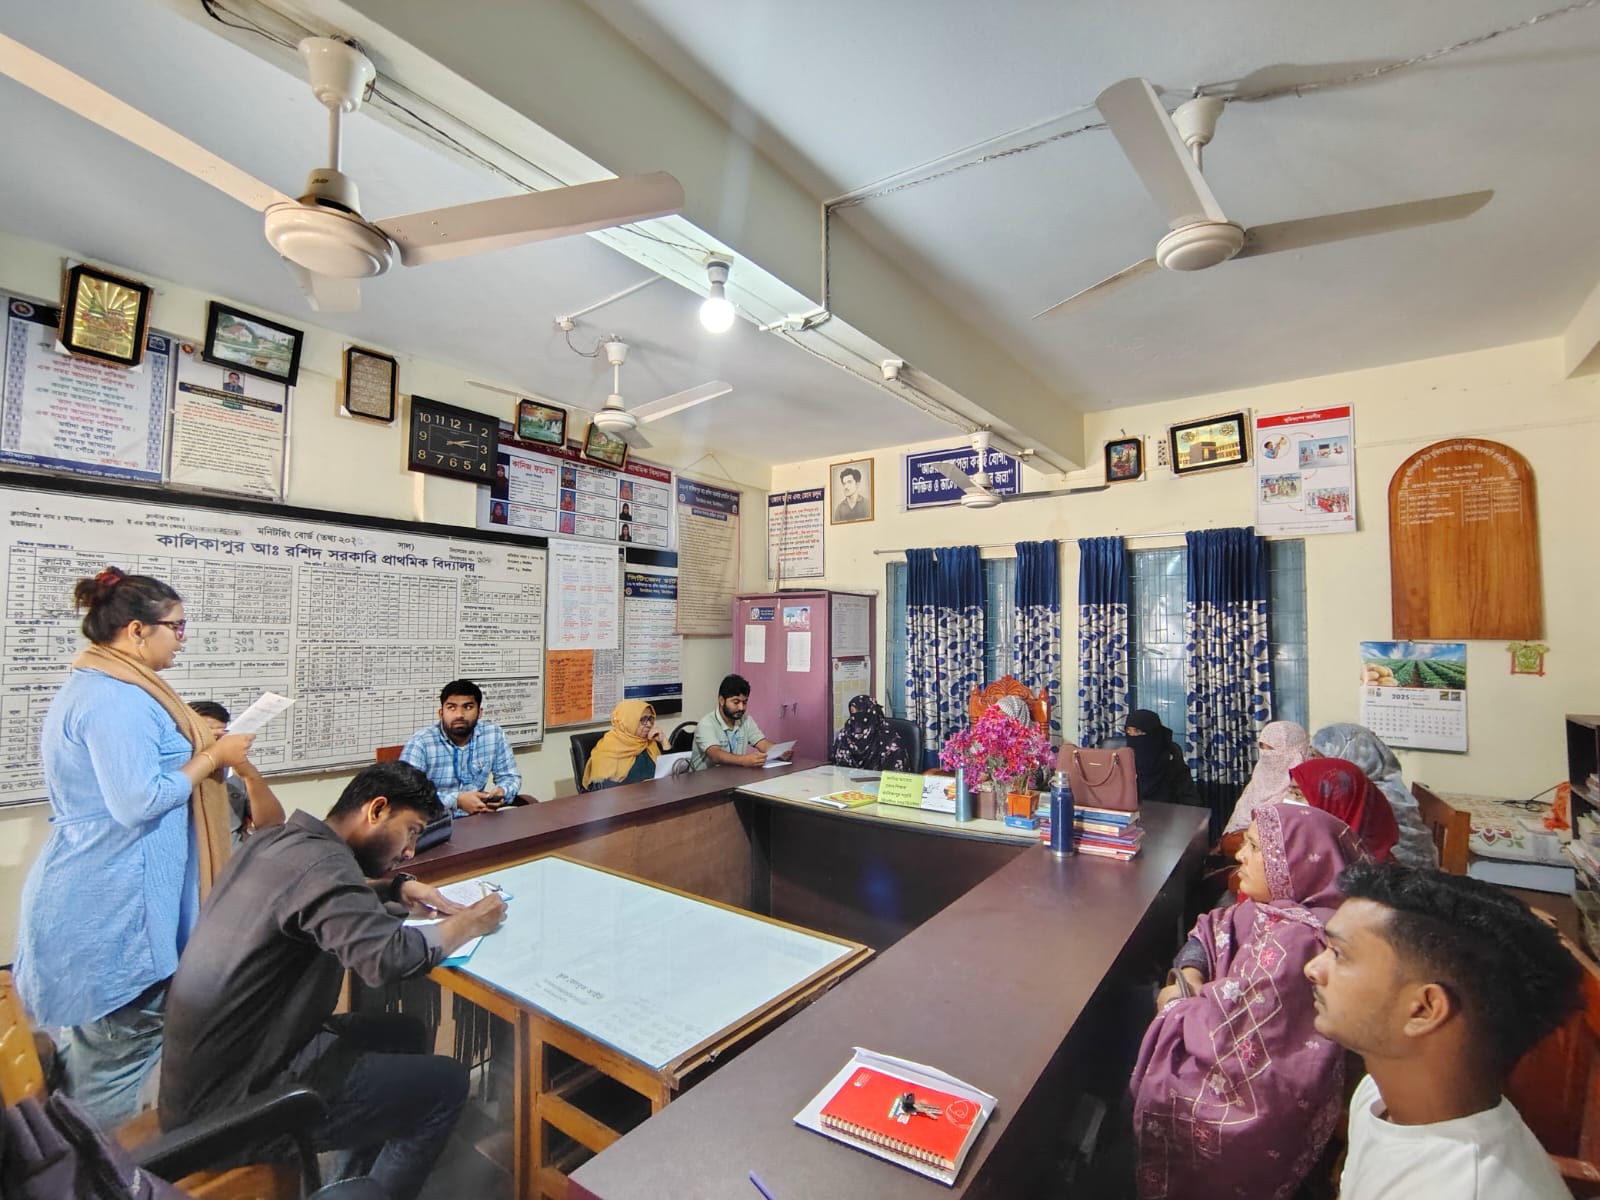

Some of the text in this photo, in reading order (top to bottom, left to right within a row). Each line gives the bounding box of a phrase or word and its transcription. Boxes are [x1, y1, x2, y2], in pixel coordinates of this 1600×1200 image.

[419, 412, 431, 423] 10
[435, 415, 445, 425] 11
[450, 418, 461, 429] 12
[468, 423, 472, 432] 1
[419, 431, 427, 441] 9
[481, 428, 488, 438] 2
[418, 450, 426, 459] 8
[480, 445, 488, 455] 3
[436, 455, 444, 464] 7
[450, 458, 457, 467] 6
[464, 461, 472, 470] 5
[480, 463, 487, 472] 4
[512, 460, 532, 470] কানিজ
[912, 476, 933, 494] শিক্ষিত
[934, 480, 939, 492] ও
[257, 526, 291, 539] মনিটরিং
[294, 530, 314, 540] বোর্ড
[316, 533, 336, 543] (তথ্য
[398, 542, 415, 552] সাল)
[156, 532, 476, 573] কালিকাপুর আঃ রশিদ সরকারি প্রাথমিক বিদ্যালয়
